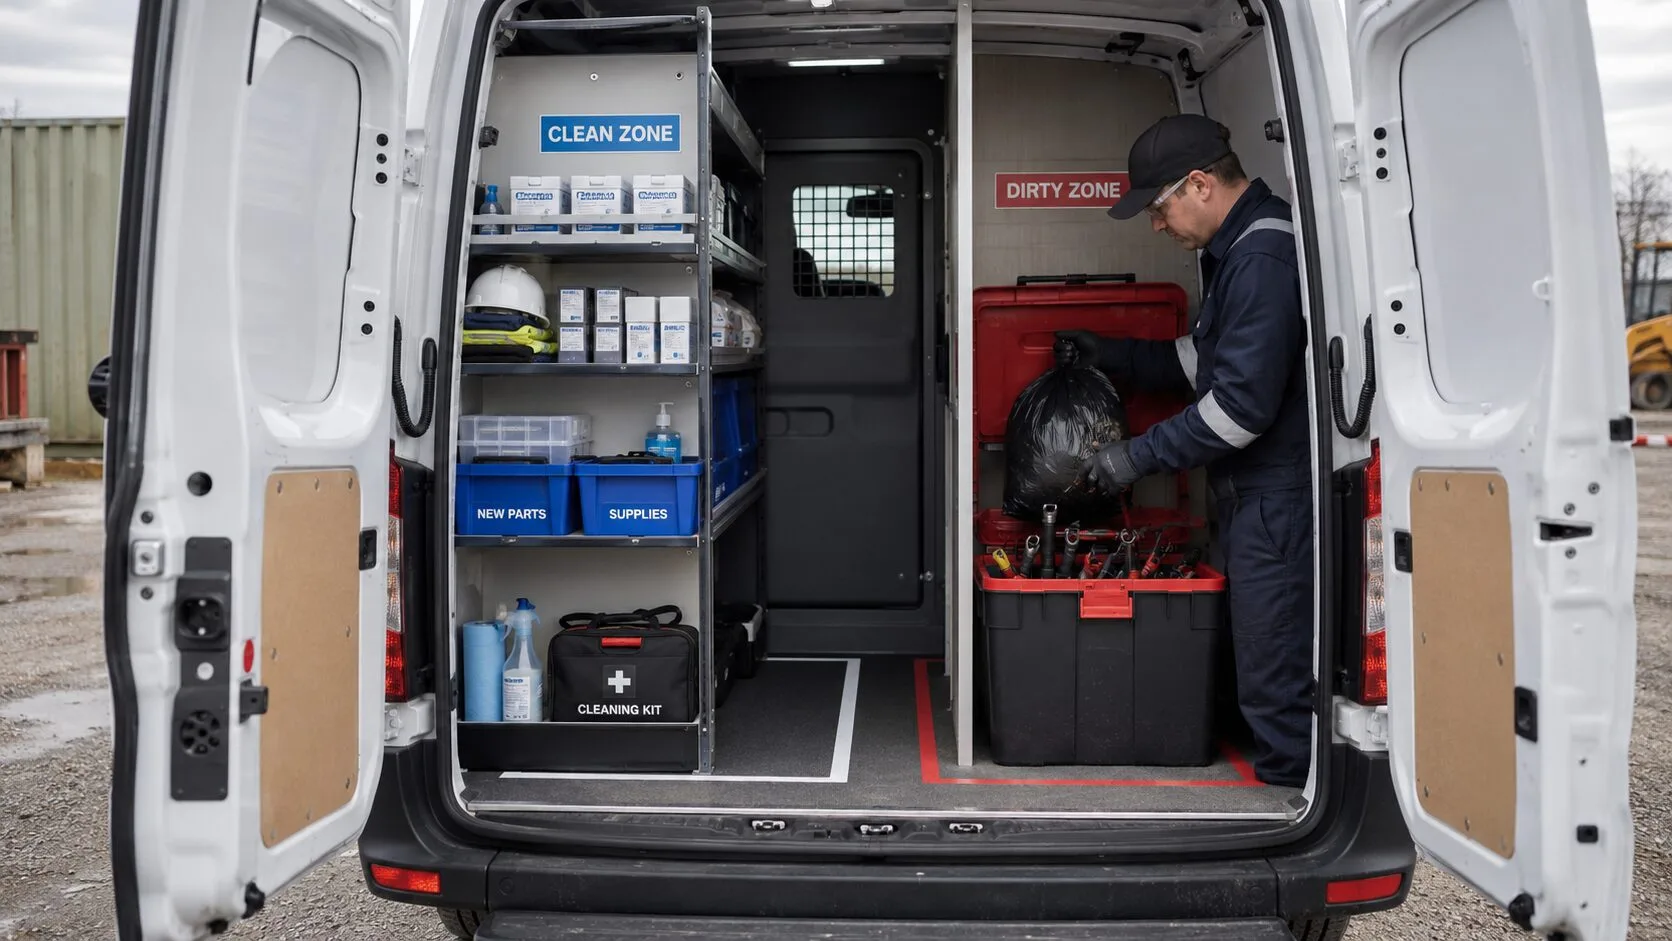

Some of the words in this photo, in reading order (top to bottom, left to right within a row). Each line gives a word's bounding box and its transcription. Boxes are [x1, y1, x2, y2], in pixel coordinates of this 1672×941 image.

[548, 125, 613, 143] CLEAN
[619, 125, 673, 142] ZONE
[1006, 183, 1064, 199] DIRTY
[1068, 182, 1121, 198] ZONE
[477, 508, 504, 519] NEW
[507, 508, 547, 519] PARTS
[609, 508, 668, 520] SUPPLIES
[577, 703, 639, 716] CLEANING
[643, 704, 662, 715] KIT
